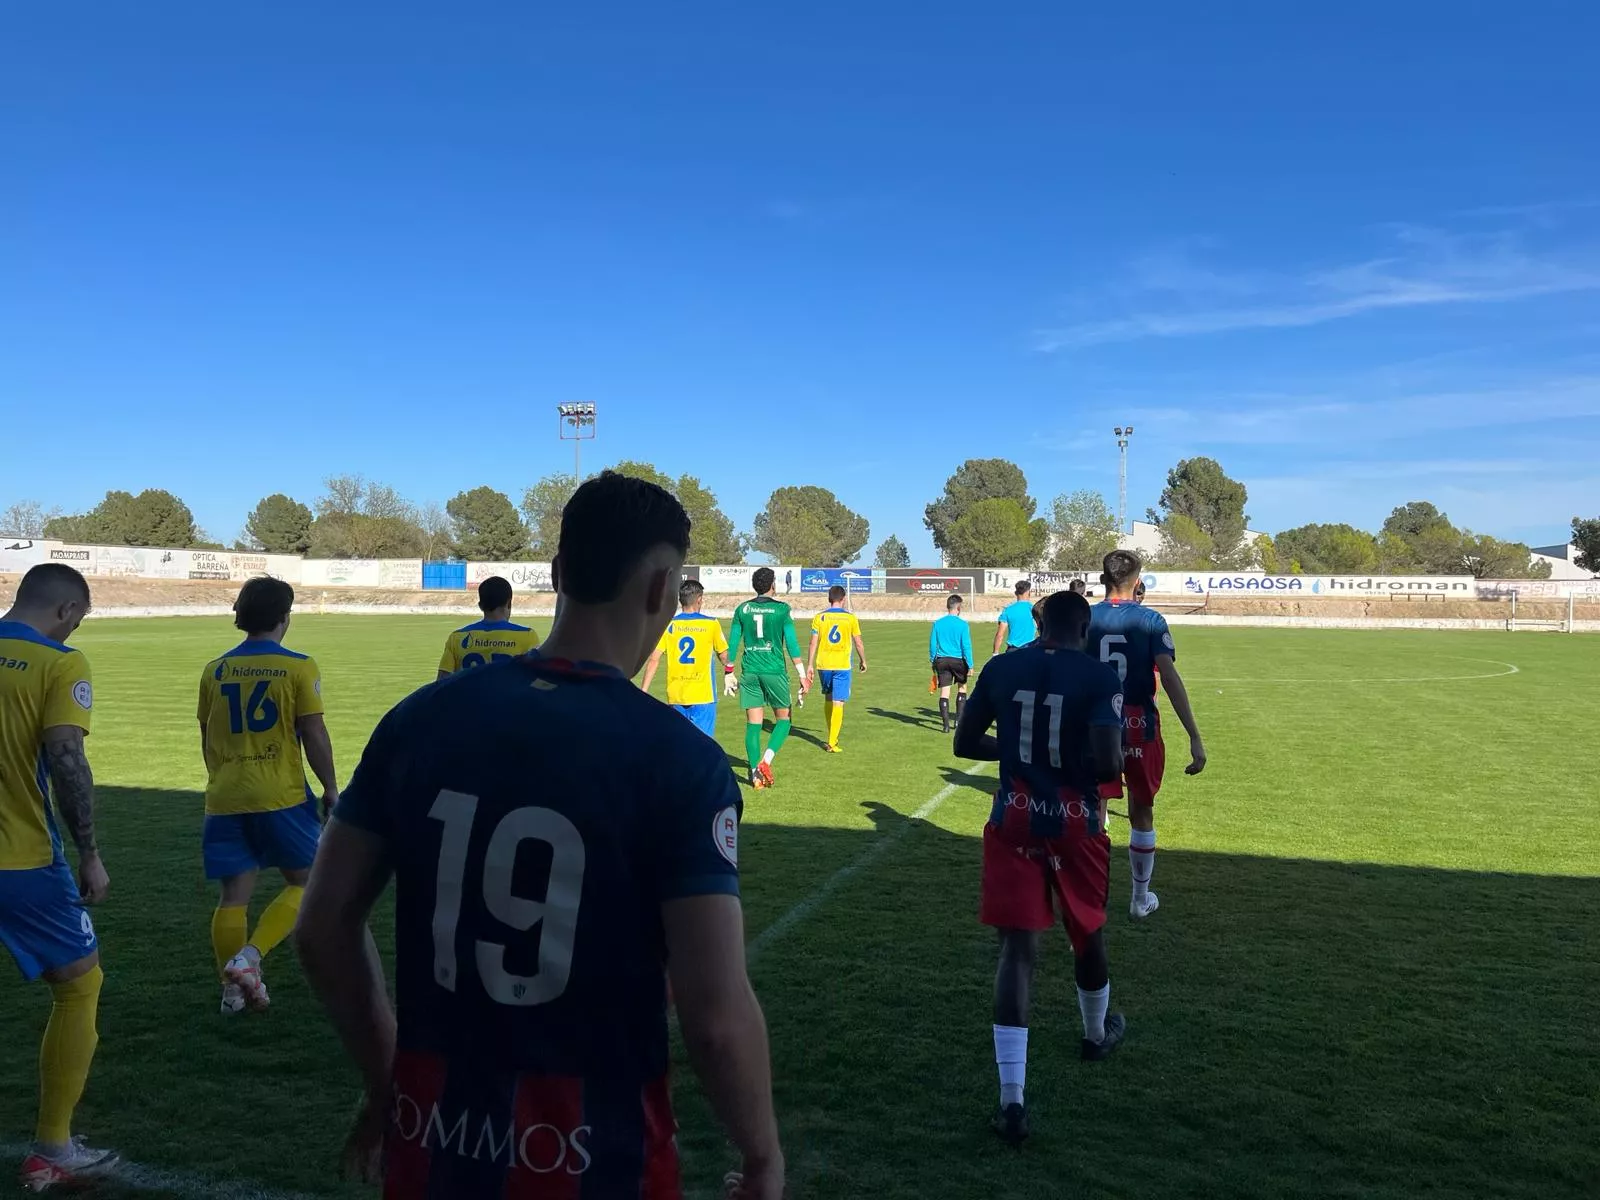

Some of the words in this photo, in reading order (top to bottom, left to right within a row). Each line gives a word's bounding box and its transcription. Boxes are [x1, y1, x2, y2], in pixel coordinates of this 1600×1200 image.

[52, 551, 88, 560] MOMPRADE
[1208, 577, 1302, 590] LASAOSA
[1330, 578, 1468, 591] hidroman
[753, 614, 765, 638] 1
[828, 624, 841, 643] 6
[474, 640, 516, 648] hidroman
[678, 636, 695, 664] 2
[231, 666, 287, 678] hidroman
[1100, 634, 1128, 683] 5
[220, 680, 279, 734] 16
[1011, 689, 1064, 769] 11
[1004, 791, 1090, 818] SOMMOS
[427, 788, 586, 1006] 19
[80, 910, 96, 946] 9
[394, 1091, 592, 1176] OMMOS
